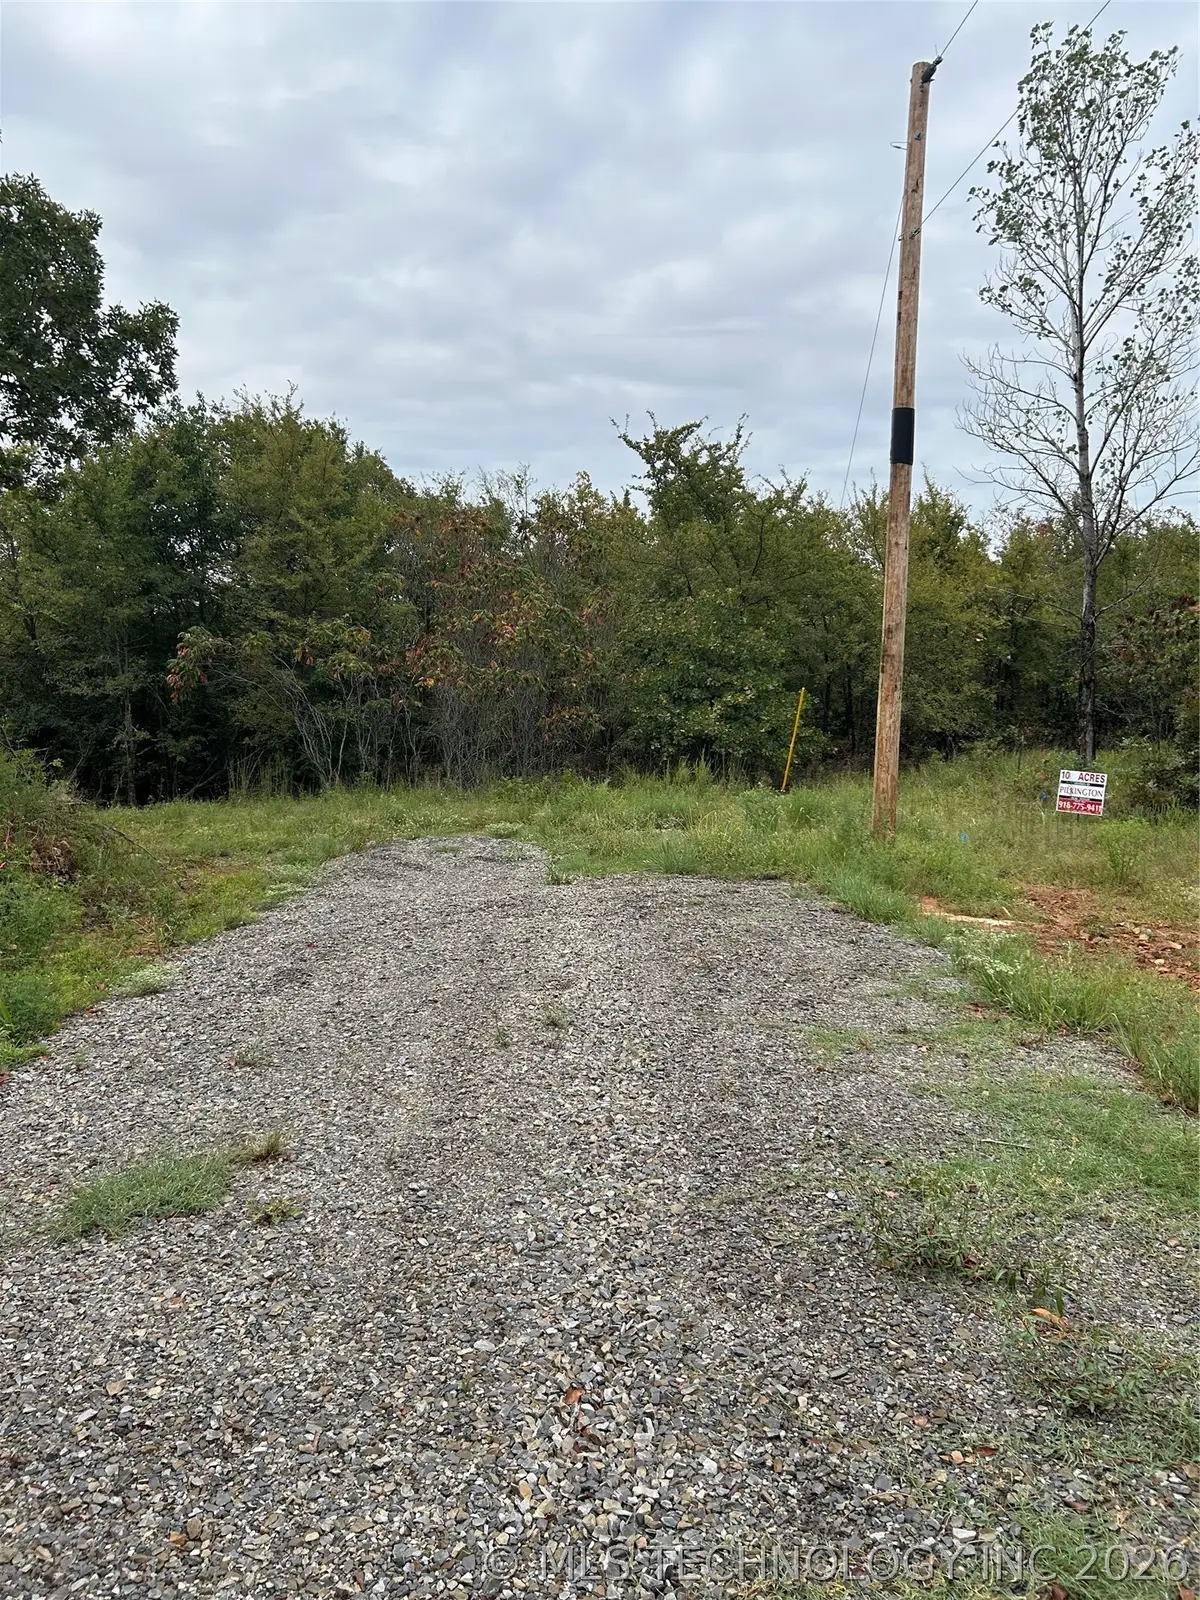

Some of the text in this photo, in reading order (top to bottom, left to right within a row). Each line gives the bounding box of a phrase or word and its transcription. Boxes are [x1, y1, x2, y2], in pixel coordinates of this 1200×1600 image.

[1062, 771, 1106, 783] 10 ACRES
[1060, 786, 1103, 797] PILKINGTON
